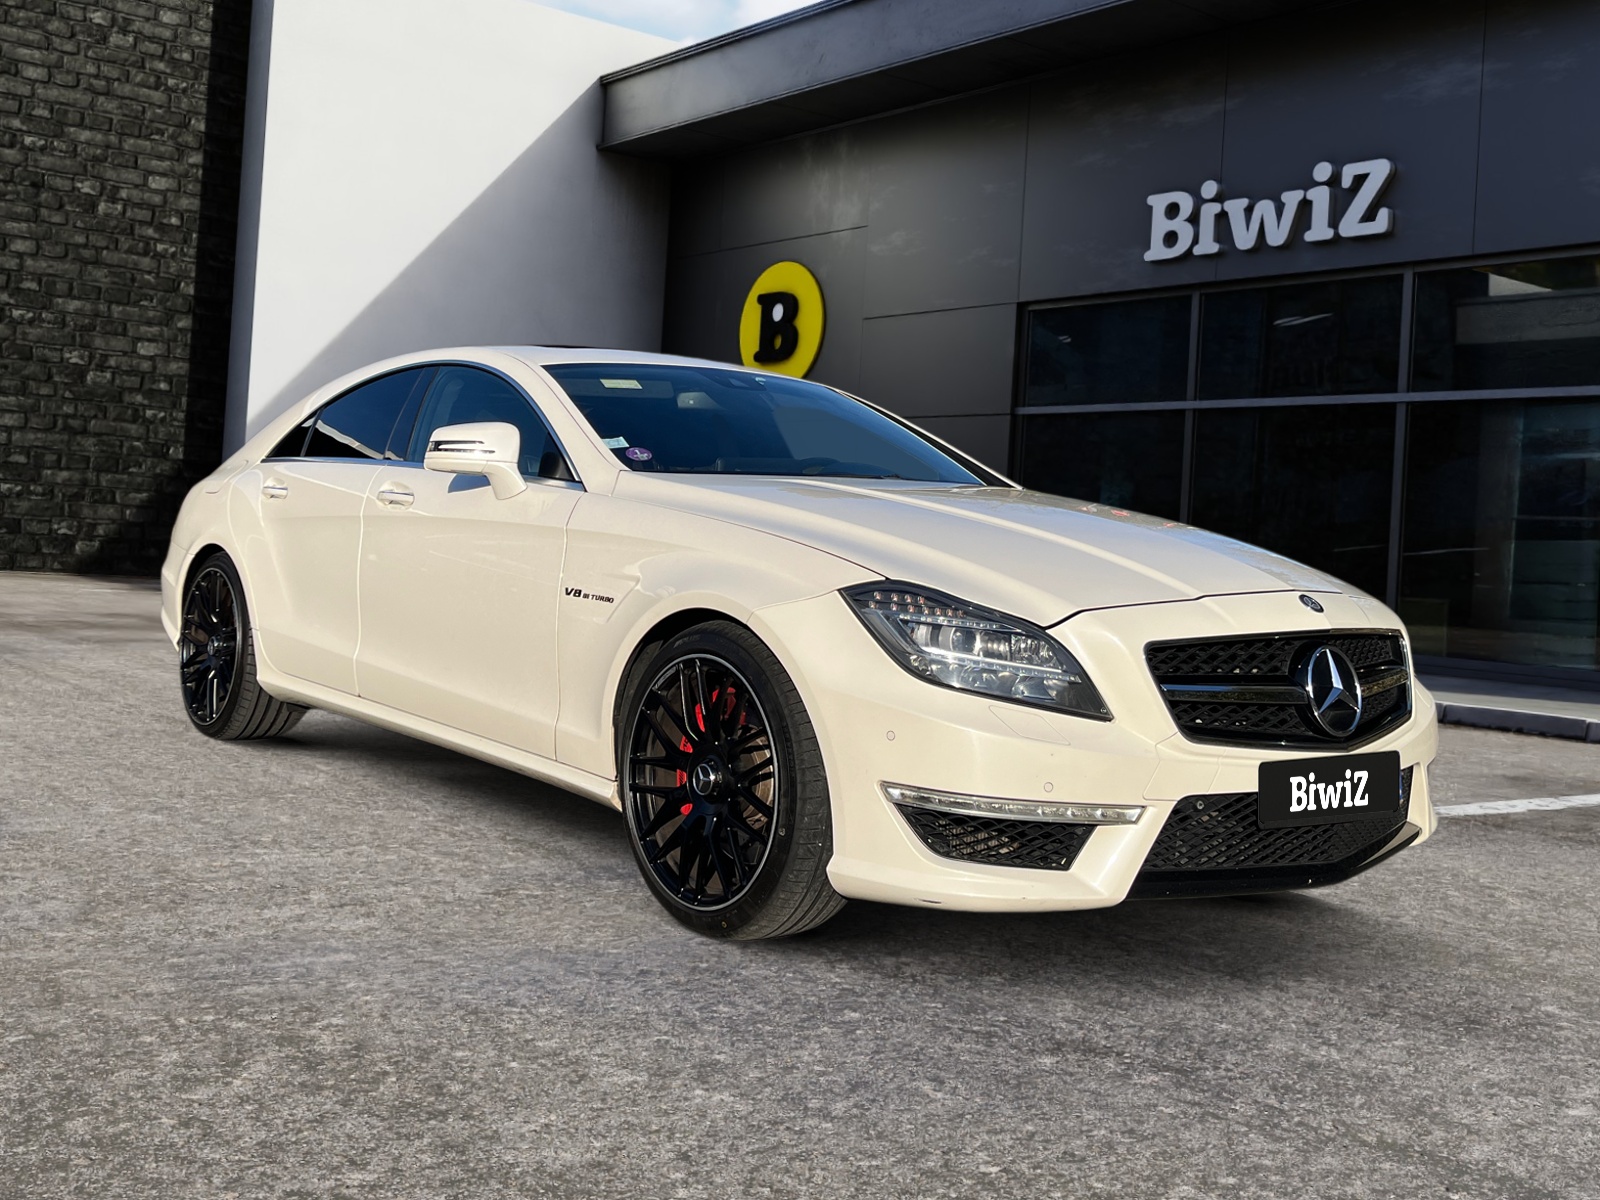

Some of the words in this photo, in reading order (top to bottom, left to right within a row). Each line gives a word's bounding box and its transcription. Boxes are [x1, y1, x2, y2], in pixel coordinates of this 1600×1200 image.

[1143, 158, 1395, 262] BiwiZ
[753, 291, 799, 363] B
[565, 587, 582, 597] V8
[591, 594, 614, 603] TURBO
[1289, 768, 1369, 812] BiwiZ
